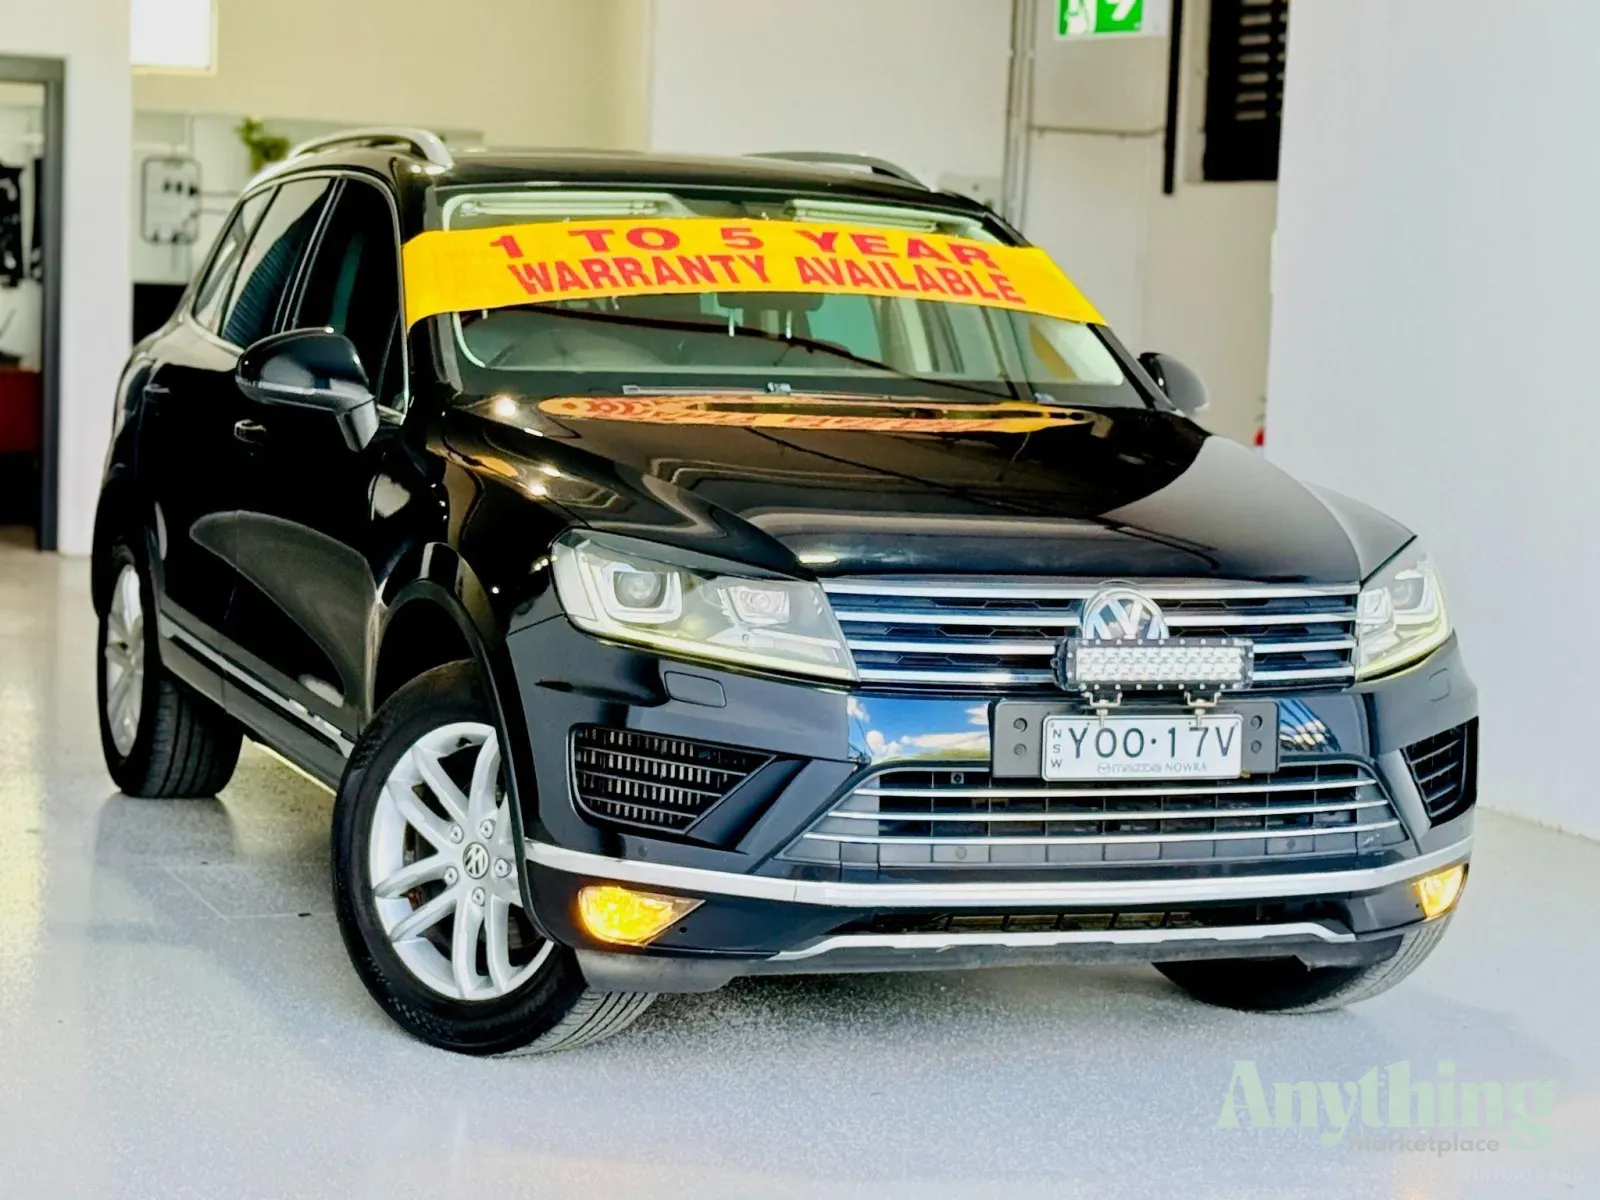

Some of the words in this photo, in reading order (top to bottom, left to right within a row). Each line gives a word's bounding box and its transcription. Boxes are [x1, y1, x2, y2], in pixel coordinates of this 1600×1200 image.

[490, 234, 524, 259] 1
[568, 227, 680, 252] TO
[720, 227, 764, 250] 5
[794, 230, 1000, 270] YEAR
[507, 254, 771, 296] WARRANTY
[794, 256, 1027, 304] AVAILABLE
[1165, 762, 1208, 773] NOWRA
